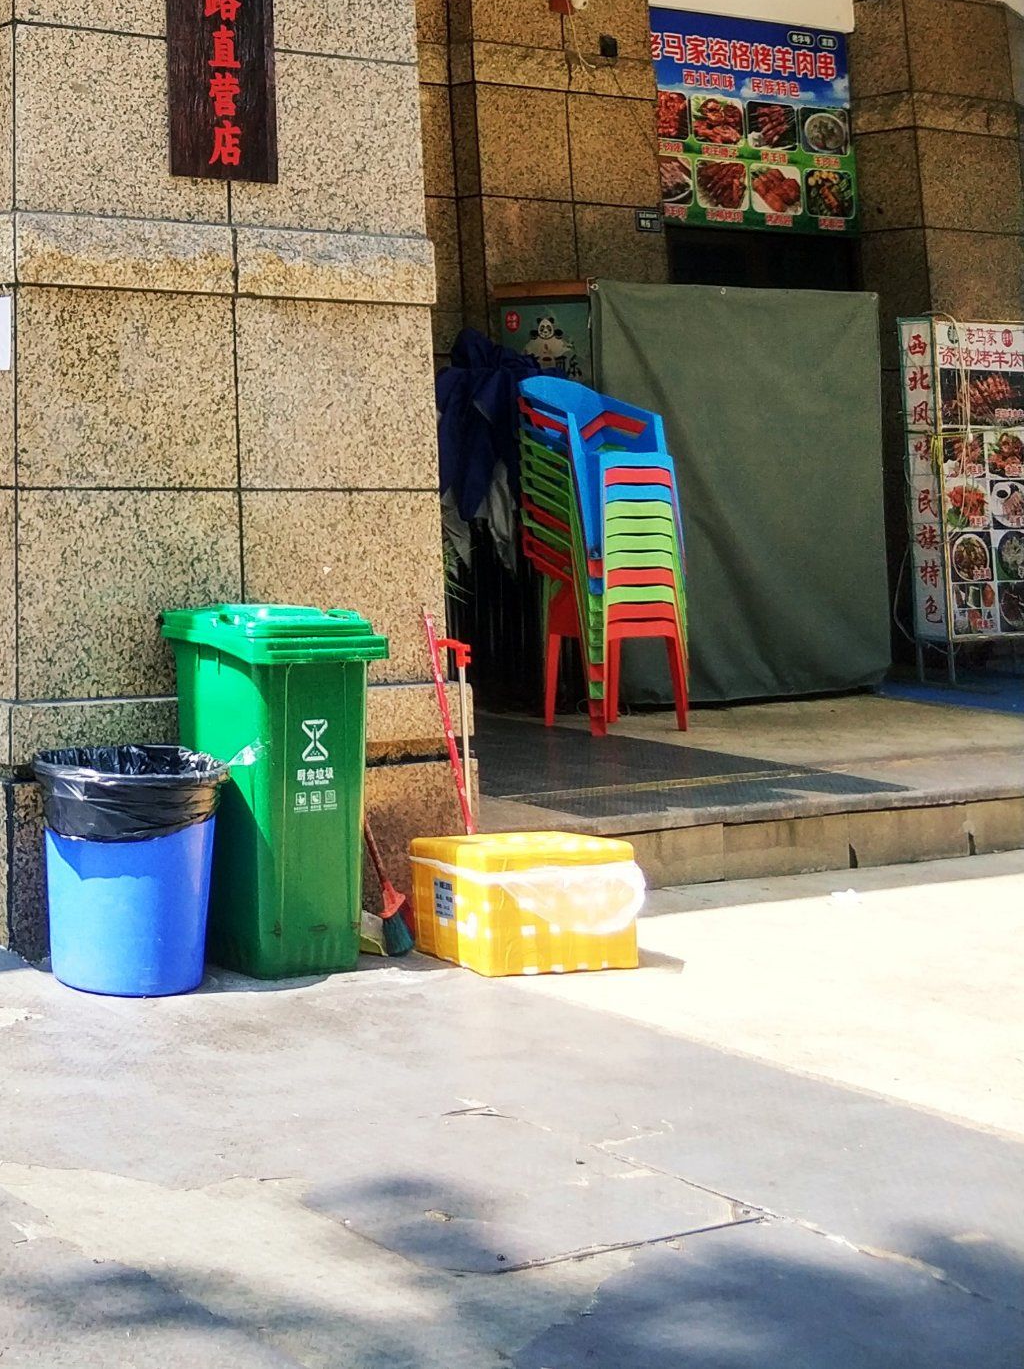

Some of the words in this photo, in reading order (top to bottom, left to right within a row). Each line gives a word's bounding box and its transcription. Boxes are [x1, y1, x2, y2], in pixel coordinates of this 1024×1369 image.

[682, 69, 736, 92] 西北风味
[750, 77, 802, 98] 民族特色
[296, 766, 334, 781] 厨余垃圾
